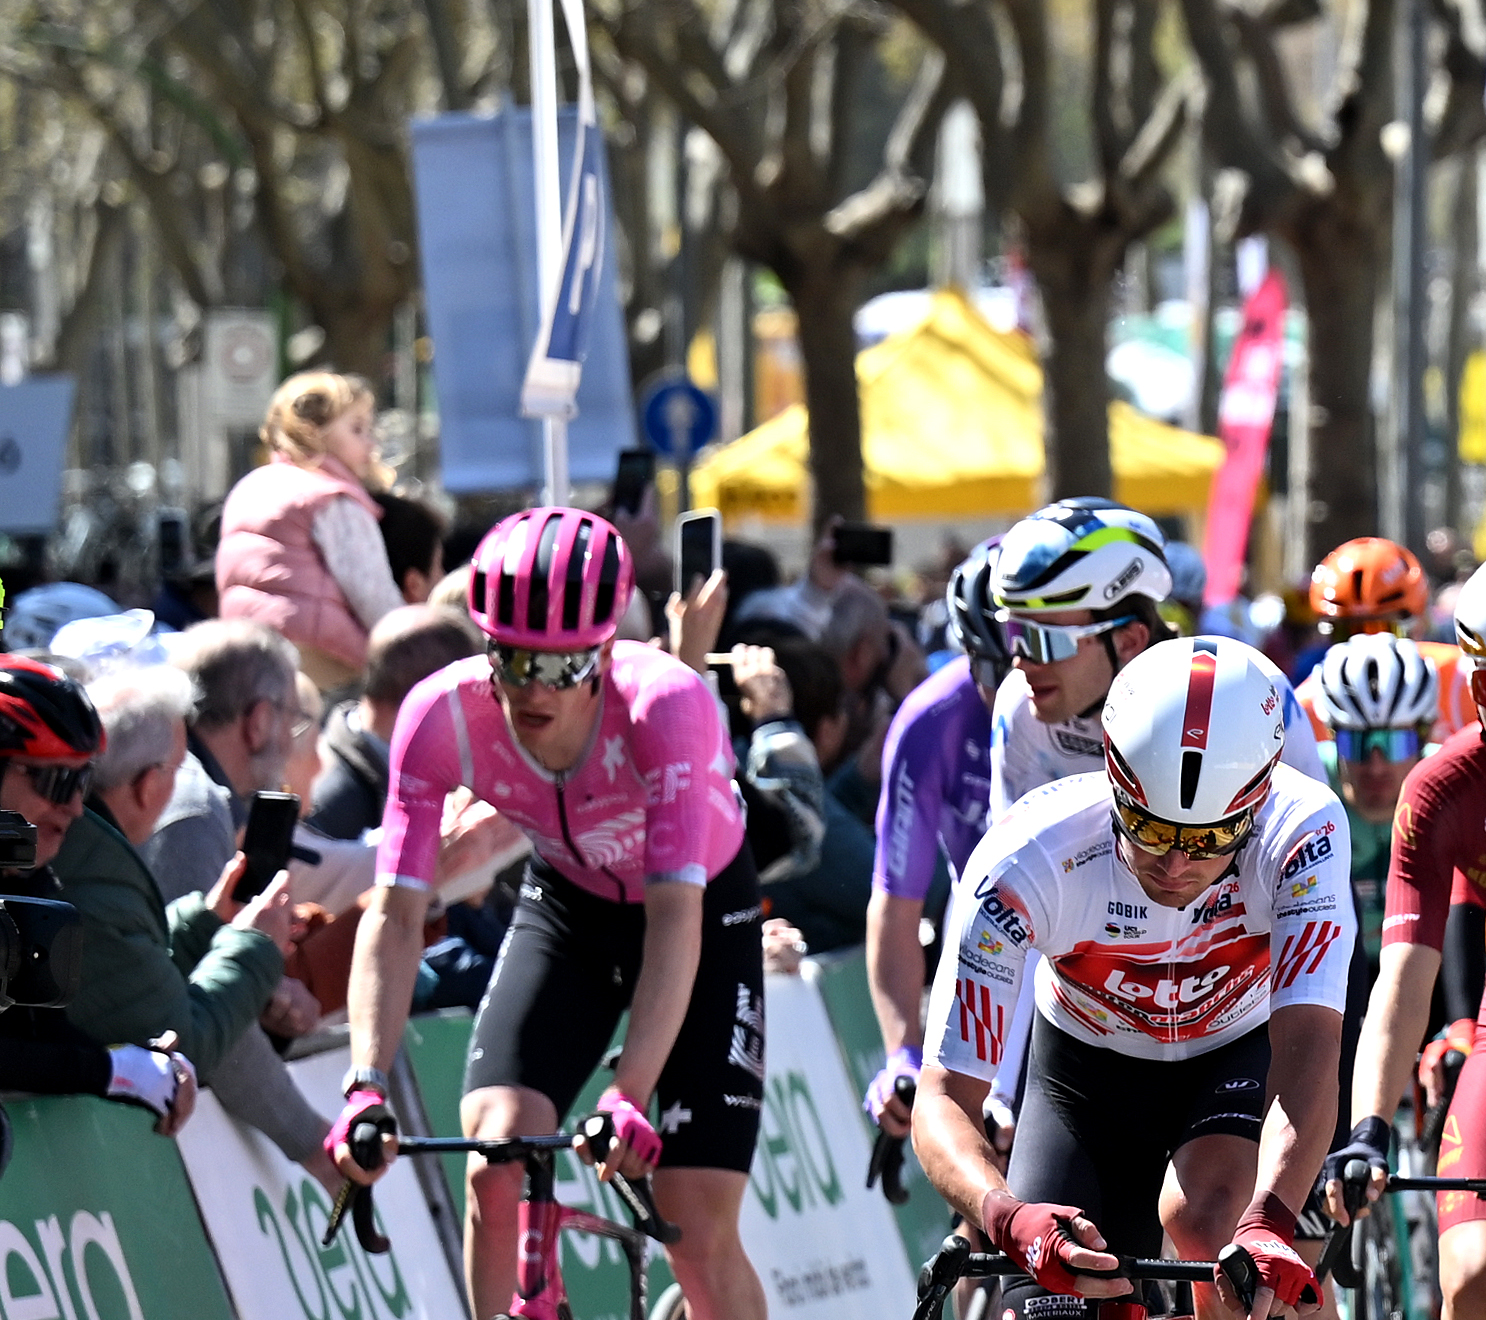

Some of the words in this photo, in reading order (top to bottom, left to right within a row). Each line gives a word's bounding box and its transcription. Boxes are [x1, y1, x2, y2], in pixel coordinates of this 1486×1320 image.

[974, 875, 1028, 944] Volta
[1108, 901, 1148, 919] GOBIK
[1104, 965, 1230, 1008] Lotto
[1027, 1295, 1084, 1307] GOBERT
[1027, 1309, 1083, 1318] MATERIAUX
